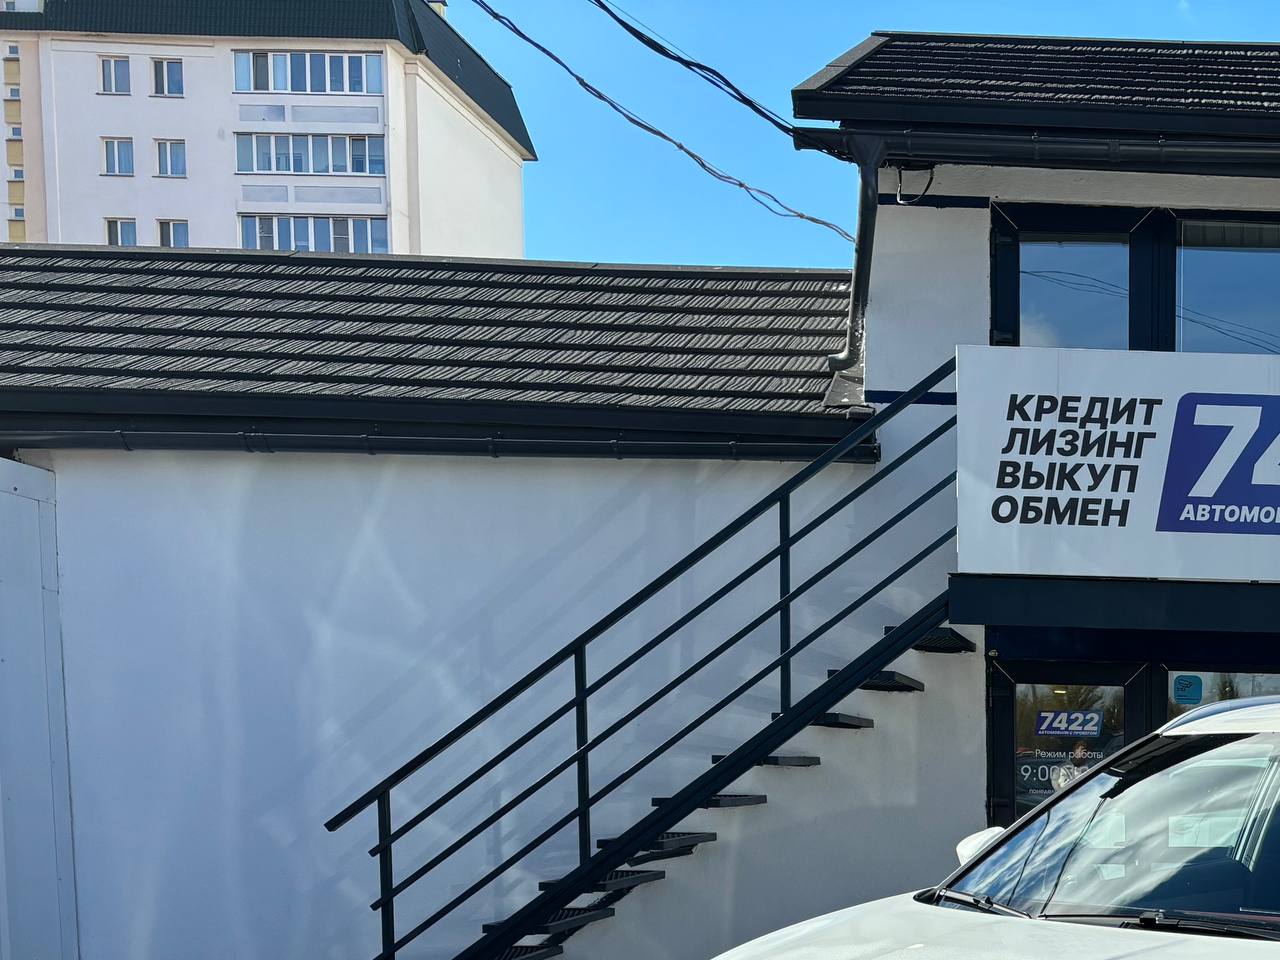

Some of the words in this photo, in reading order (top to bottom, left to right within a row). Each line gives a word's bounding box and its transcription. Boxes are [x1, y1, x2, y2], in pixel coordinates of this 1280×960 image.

[1006, 394, 1163, 430] КРЕДИТ
[1001, 427, 1157, 459] ЛИЗИНГ
[996, 460, 1139, 493] ВЫКУП
[991, 495, 1130, 527] ОБМЕН
[1039, 712, 1099, 731] 7422
[1035, 749, 1066, 758] Режим
[1068, 750, 1104, 760] работы
